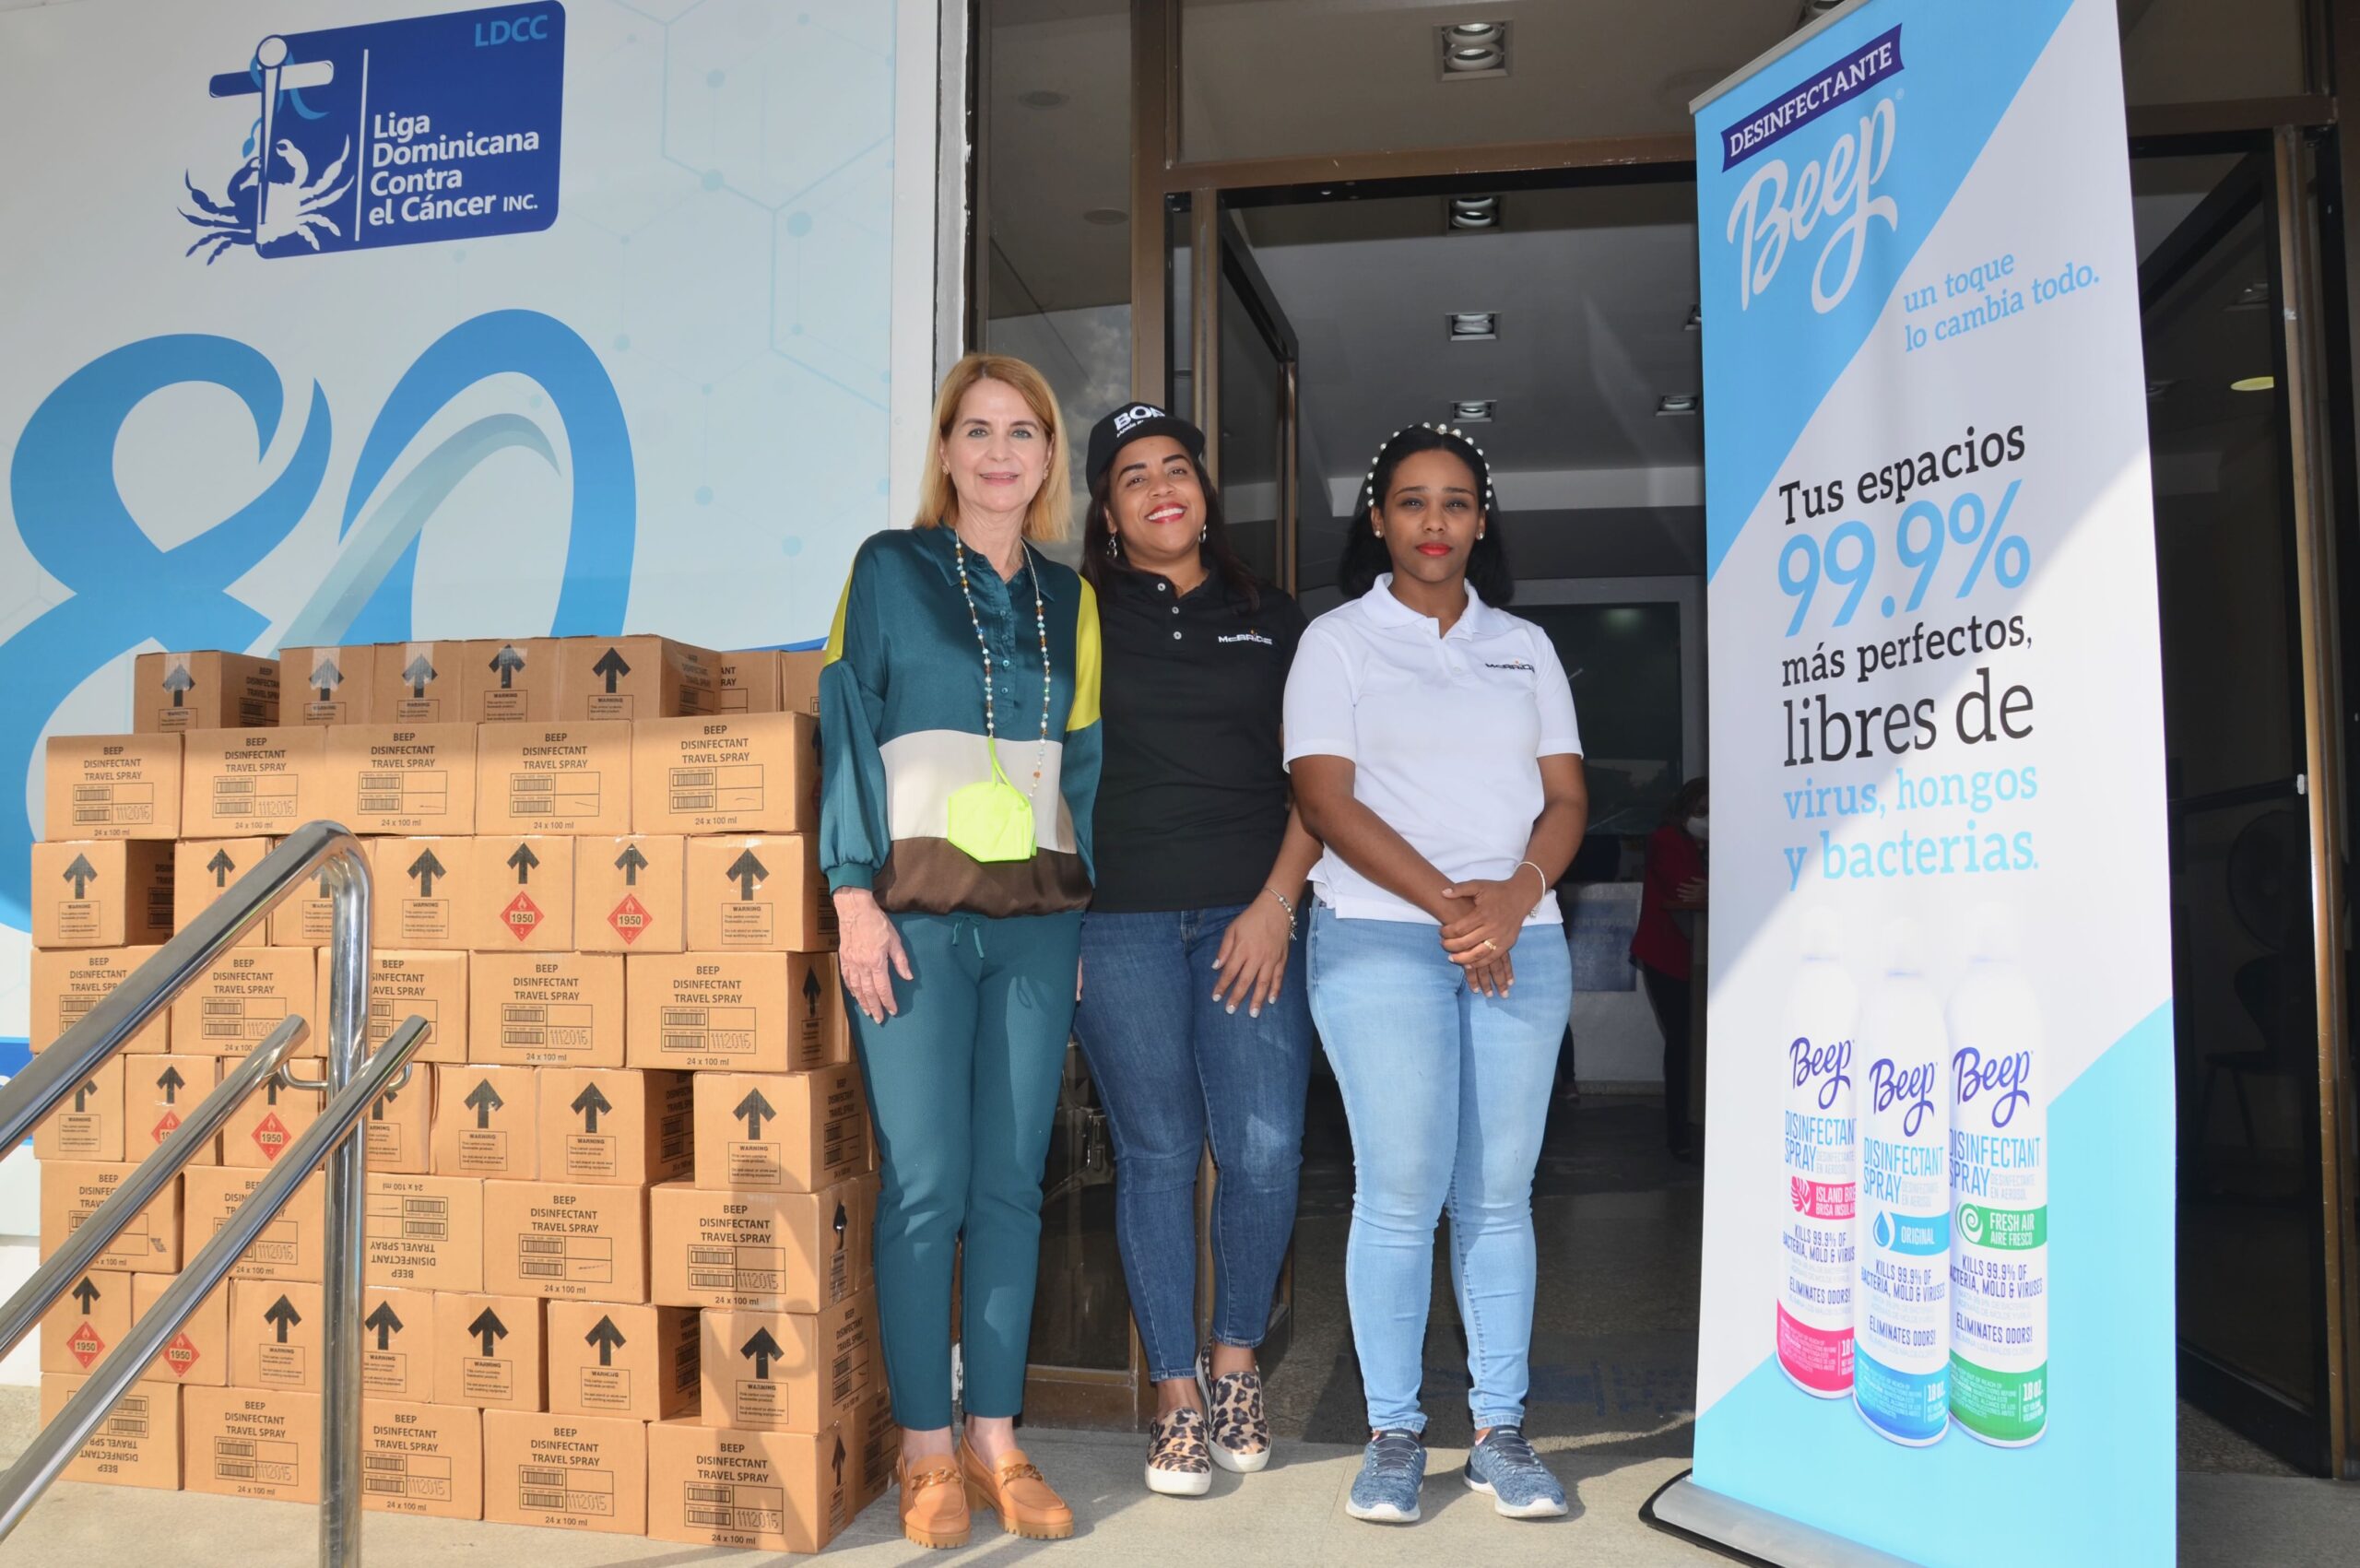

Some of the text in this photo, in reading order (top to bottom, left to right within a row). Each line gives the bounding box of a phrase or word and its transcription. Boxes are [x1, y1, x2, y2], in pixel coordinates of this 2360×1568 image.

[475, 15, 549, 47] LDCC
[1729, 41, 1894, 158] DESINFECTANTE
[373, 112, 431, 143] Liga
[372, 131, 539, 167] Dominicana
[371, 165, 462, 196] Contra
[369, 193, 538, 226] el Cáncer INC.
[1727, 98, 1899, 314] Beep
[1904, 253, 2015, 314] un toque
[1905, 261, 2101, 352] lo cambia todo.
[1779, 425, 2025, 525] Tus espacios
[1777, 478, 2031, 638] 99.9%
[1782, 614, 2033, 687] más perfectos,
[1783, 666, 2035, 767] libres de
[704, 725, 726, 735] BEEP
[246, 737, 267, 747] BEEP
[394, 733, 415, 741] BEEP
[546, 733, 567, 742] BEEP
[681, 738, 749, 749] DISINFECTANT
[103, 747, 124, 755] BEEP
[225, 749, 286, 760] DISINFECTANT
[372, 746, 435, 754] DISINFECTANT
[523, 746, 587, 756] DISINFECTANT
[84, 759, 141, 768] DISINFECTANT
[682, 752, 749, 763] TRAVEL SPRAY
[226, 762, 287, 772] TRAVEL SPRAY
[524, 760, 587, 769] TRAVEL SPRAY
[117, 772, 141, 781] SPRAY
[1783, 765, 2039, 820] virus, hongos
[1784, 819, 2039, 892] y bacterias.
[512, 914, 533, 923] 1950
[619, 915, 641, 925] 1950
[234, 959, 254, 968] BEEP
[536, 964, 558, 973] BEEP
[697, 966, 719, 974] BEEP
[213, 973, 273, 981] DISINFECTANT
[513, 977, 579, 986] DISINFECTANT
[214, 985, 275, 994] TRAVEL SPRAY
[673, 980, 741, 989] DISINFECTANT
[514, 992, 579, 1001] TRAVEL SPRAY
[674, 994, 742, 1003] TRAVEL SPRAY
[1789, 1037, 1851, 1110] Beep
[1953, 1046, 2030, 1128] Beep
[1869, 1058, 1935, 1137] Beep
[1785, 1109, 1857, 1146] DISINFECTAN
[262, 1134, 281, 1142] 1950
[1785, 1137, 1817, 1173] SPRAY
[1864, 1137, 1944, 1176] DISINFECTANT
[1864, 1166, 1902, 1204] SPRAY
[553, 1196, 576, 1204] BEEP
[1816, 1185, 1842, 1203] ISLAND
[531, 1208, 597, 1220] DISINFECTANT
[724, 1205, 748, 1214] BEEP
[532, 1222, 598, 1233] TRAVEL SPRAY
[700, 1219, 771, 1229] DISINFECTANT
[1990, 1212, 2035, 1232] FRESH AIR
[701, 1233, 771, 1243] TRAVEL SPRAY
[1795, 1224, 1847, 1247] KILLS 99.9% OF
[1901, 1226, 1935, 1245] ORIGINAL
[1990, 1232, 2033, 1246] AIRE FRESCO
[371, 1242, 435, 1252] TRAVEL SPRAY
[1810, 1245, 1828, 1263] MOLD
[1837, 1246, 1855, 1263] VIRUS
[371, 1256, 435, 1266] DISINFECTANT
[1876, 1259, 1931, 1285] KILLS 99.9% OF
[1963, 1254, 2027, 1281] KILLS 99.9% OF
[391, 1269, 413, 1279] BEEP
[1950, 1264, 2043, 1298] ACTERIA, MOLD & VIRUSES
[1790, 1276, 1824, 1304] ELIMINATES
[1828, 1288, 1851, 1304] ODORS!
[1894, 1282, 1914, 1302] MOLD
[1870, 1315, 1910, 1346] ELIMINATES
[1913, 1329, 1936, 1347] ODORS!
[1956, 1312, 2002, 1343] ELIMINATES
[2006, 1326, 2033, 1344] ODORS!
[77, 1342, 95, 1351] 1950
[171, 1350, 190, 1359] 1950
[245, 1401, 266, 1409] BEEP
[225, 1413, 285, 1425] DISINFECTANT
[395, 1414, 417, 1423] BEEP
[226, 1426, 286, 1438] TRAVEL SPRAY
[373, 1426, 437, 1439] DISINFECTANT
[554, 1427, 577, 1436] BEEP
[374, 1440, 438, 1453] TRAVEL SPRAY
[531, 1440, 598, 1452] DISINFECTANT
[721, 1443, 745, 1453] BEEP
[532, 1454, 600, 1467] TRAVEL SPRAY
[697, 1456, 768, 1468] DISINFECTANT
[698, 1469, 769, 1483] TRAVEL SPRAY
